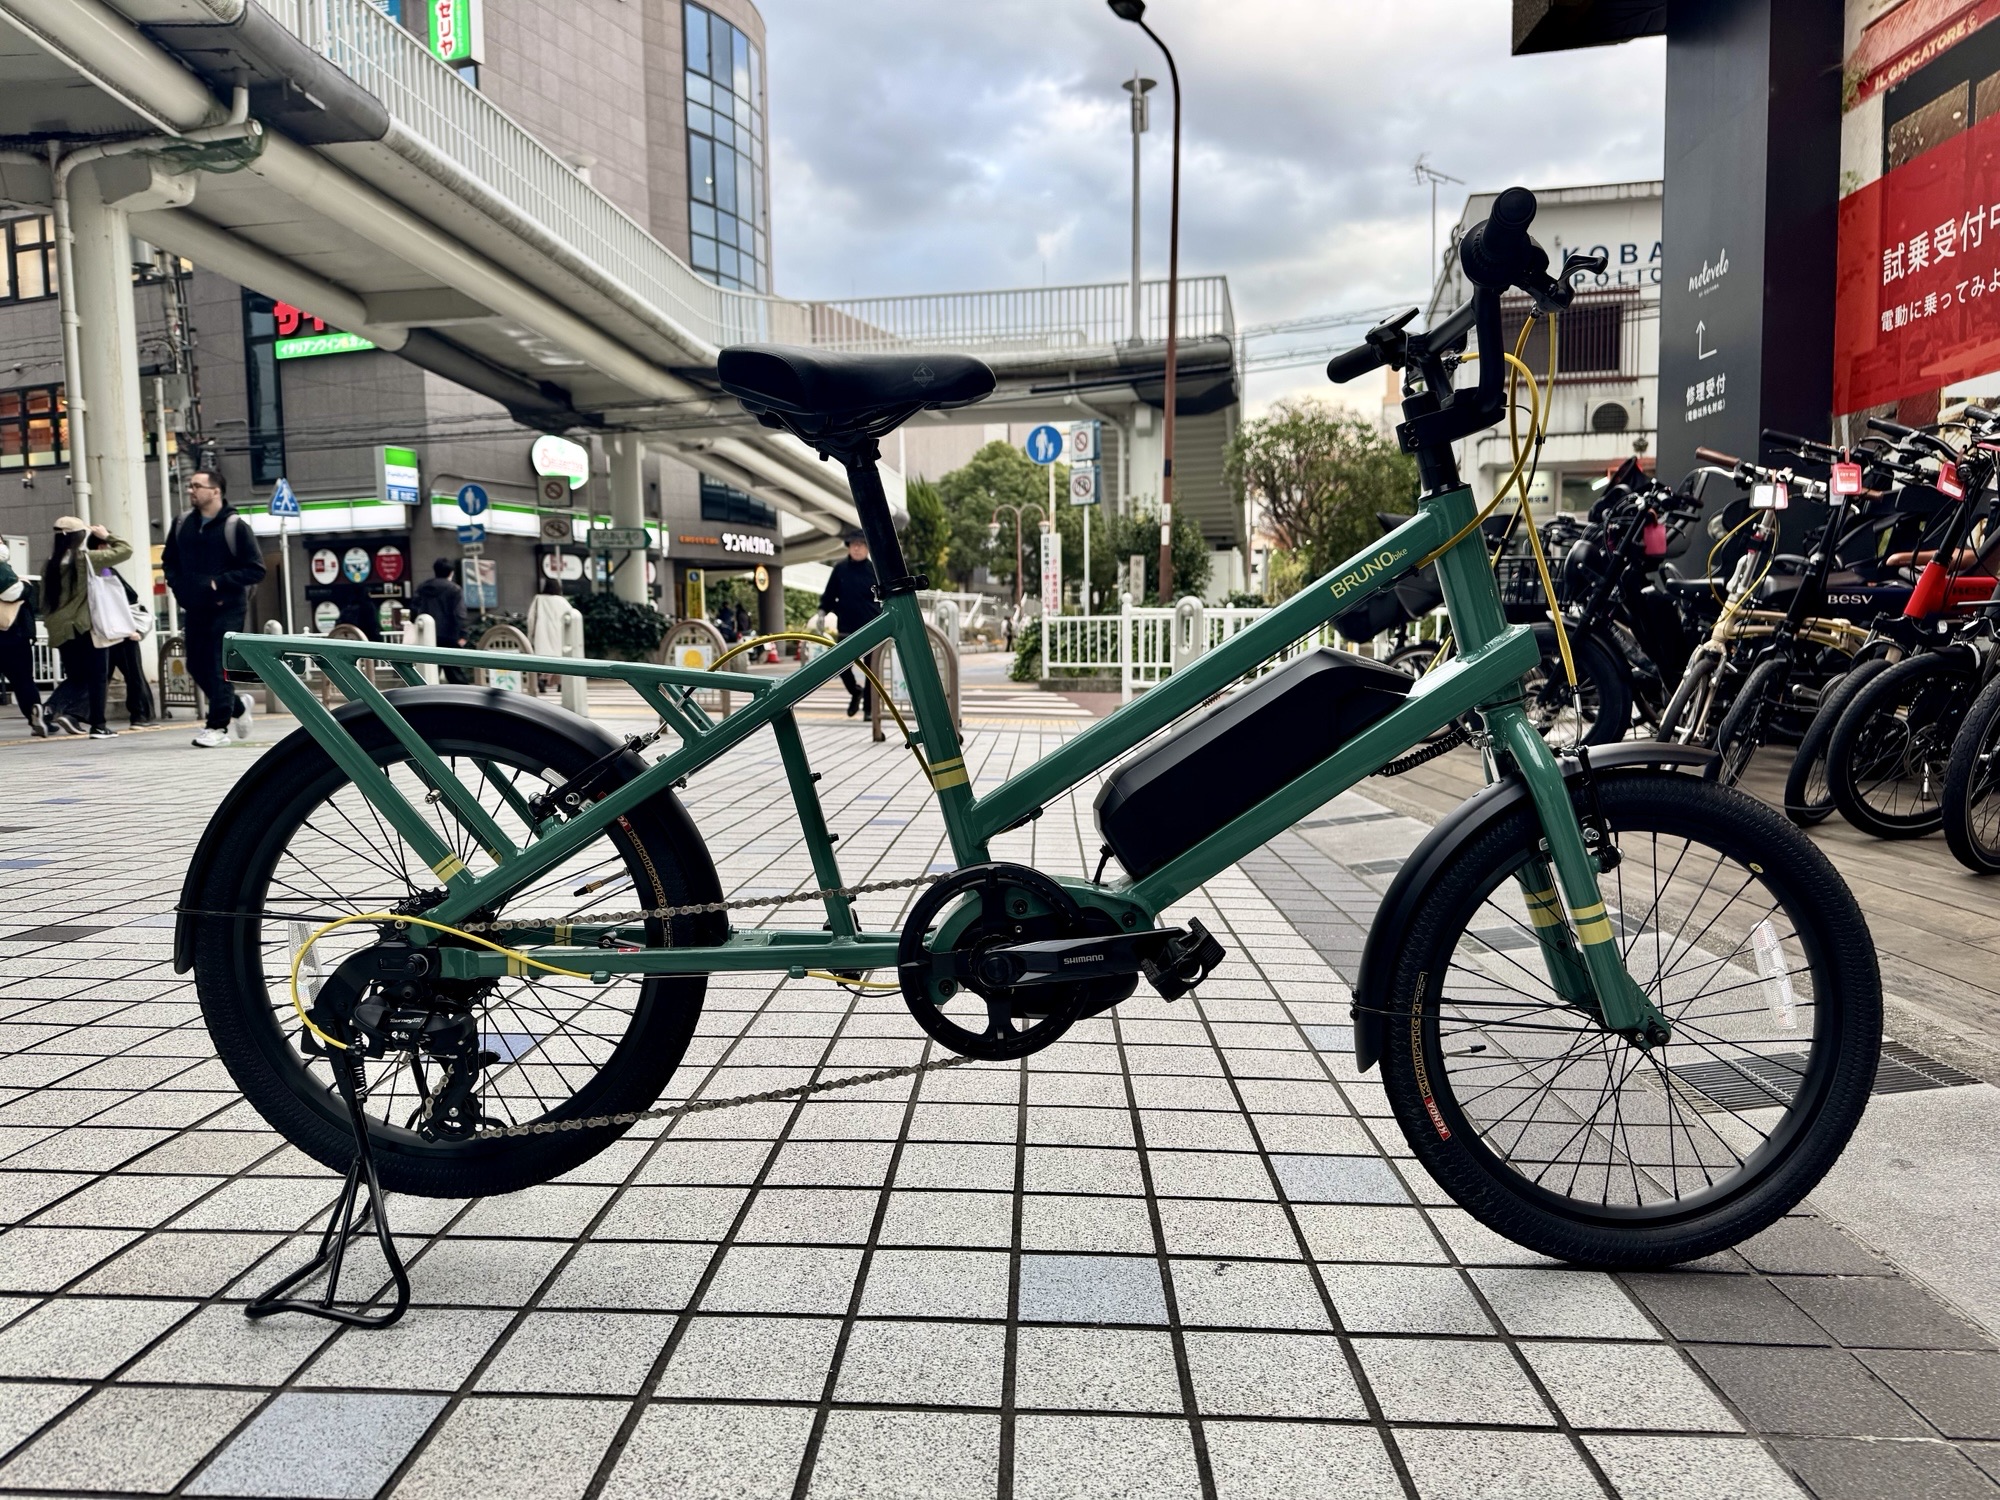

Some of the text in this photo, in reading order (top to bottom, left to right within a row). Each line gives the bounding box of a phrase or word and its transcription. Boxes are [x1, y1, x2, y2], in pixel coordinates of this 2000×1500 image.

[1887, 19, 1967, 82] GIOCATORE
[1562, 240, 1662, 267] KOBA
[1881, 267, 2000, 332] 電動に乗ってみよ
[1685, 371, 1727, 407] 修理受付
[1330, 548, 1408, 599] BRUNO bike
[628, 829, 670, 920] KINIPTIO
[1063, 954, 1105, 965] SHIMANO
[1411, 1004, 1431, 1098] KINIPTION
[1427, 1101, 1449, 1137] KENDA
